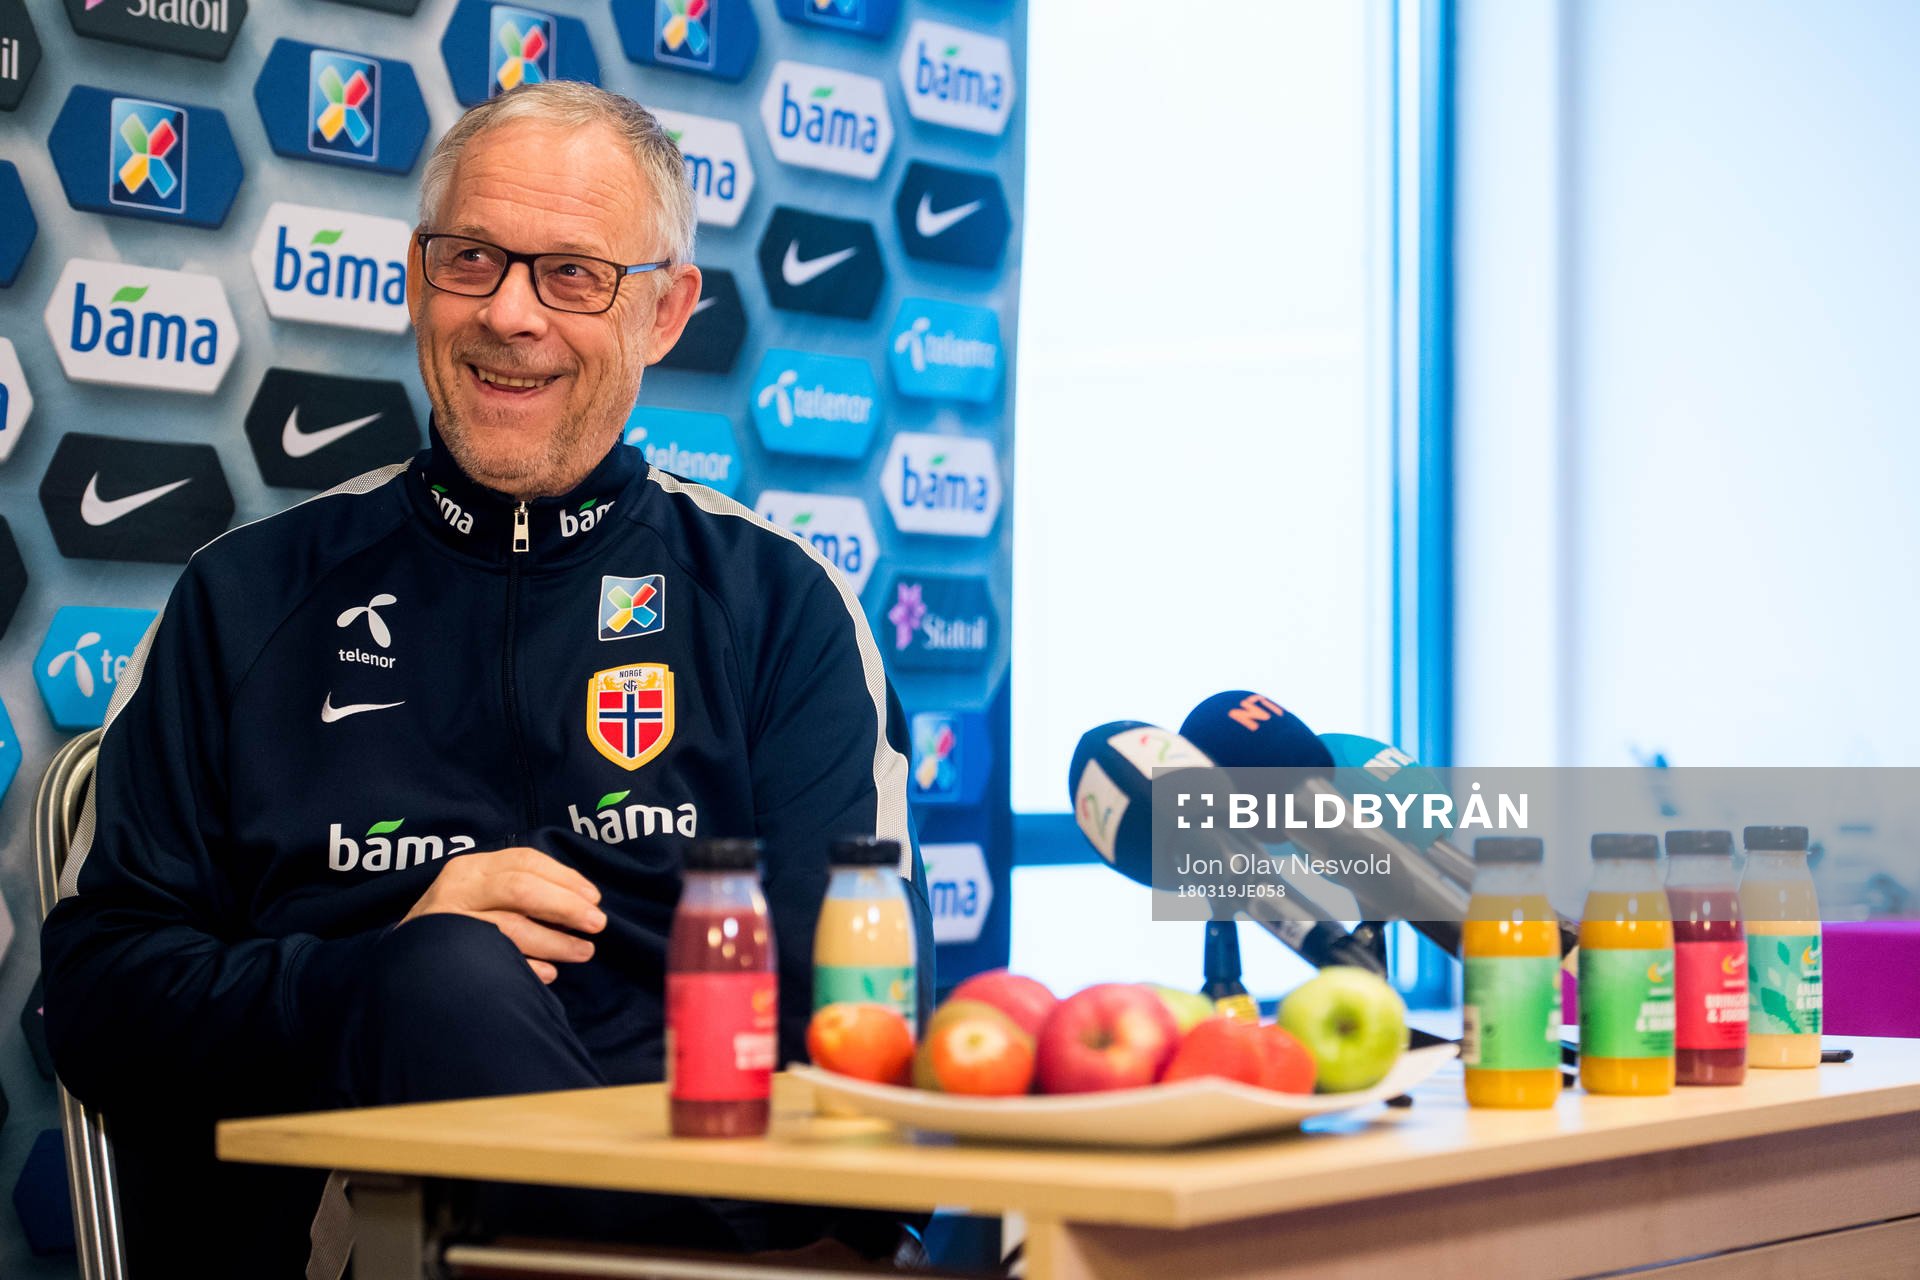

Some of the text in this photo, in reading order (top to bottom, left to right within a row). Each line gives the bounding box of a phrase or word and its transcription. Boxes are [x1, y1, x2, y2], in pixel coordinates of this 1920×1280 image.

[915, 40, 1003, 111] bama
[780, 81, 878, 155] bama
[684, 154, 735, 200] ma
[273, 225, 406, 305] bama
[70, 282, 219, 365] bama
[794, 385, 873, 424] telenor
[902, 455, 988, 511] bama
[920, 614, 988, 651] Statoil
[338, 648, 396, 669] telenor
[619, 669, 643, 678] NORGE
[1228, 694, 1284, 732] NT
[931, 882, 977, 917] ma
